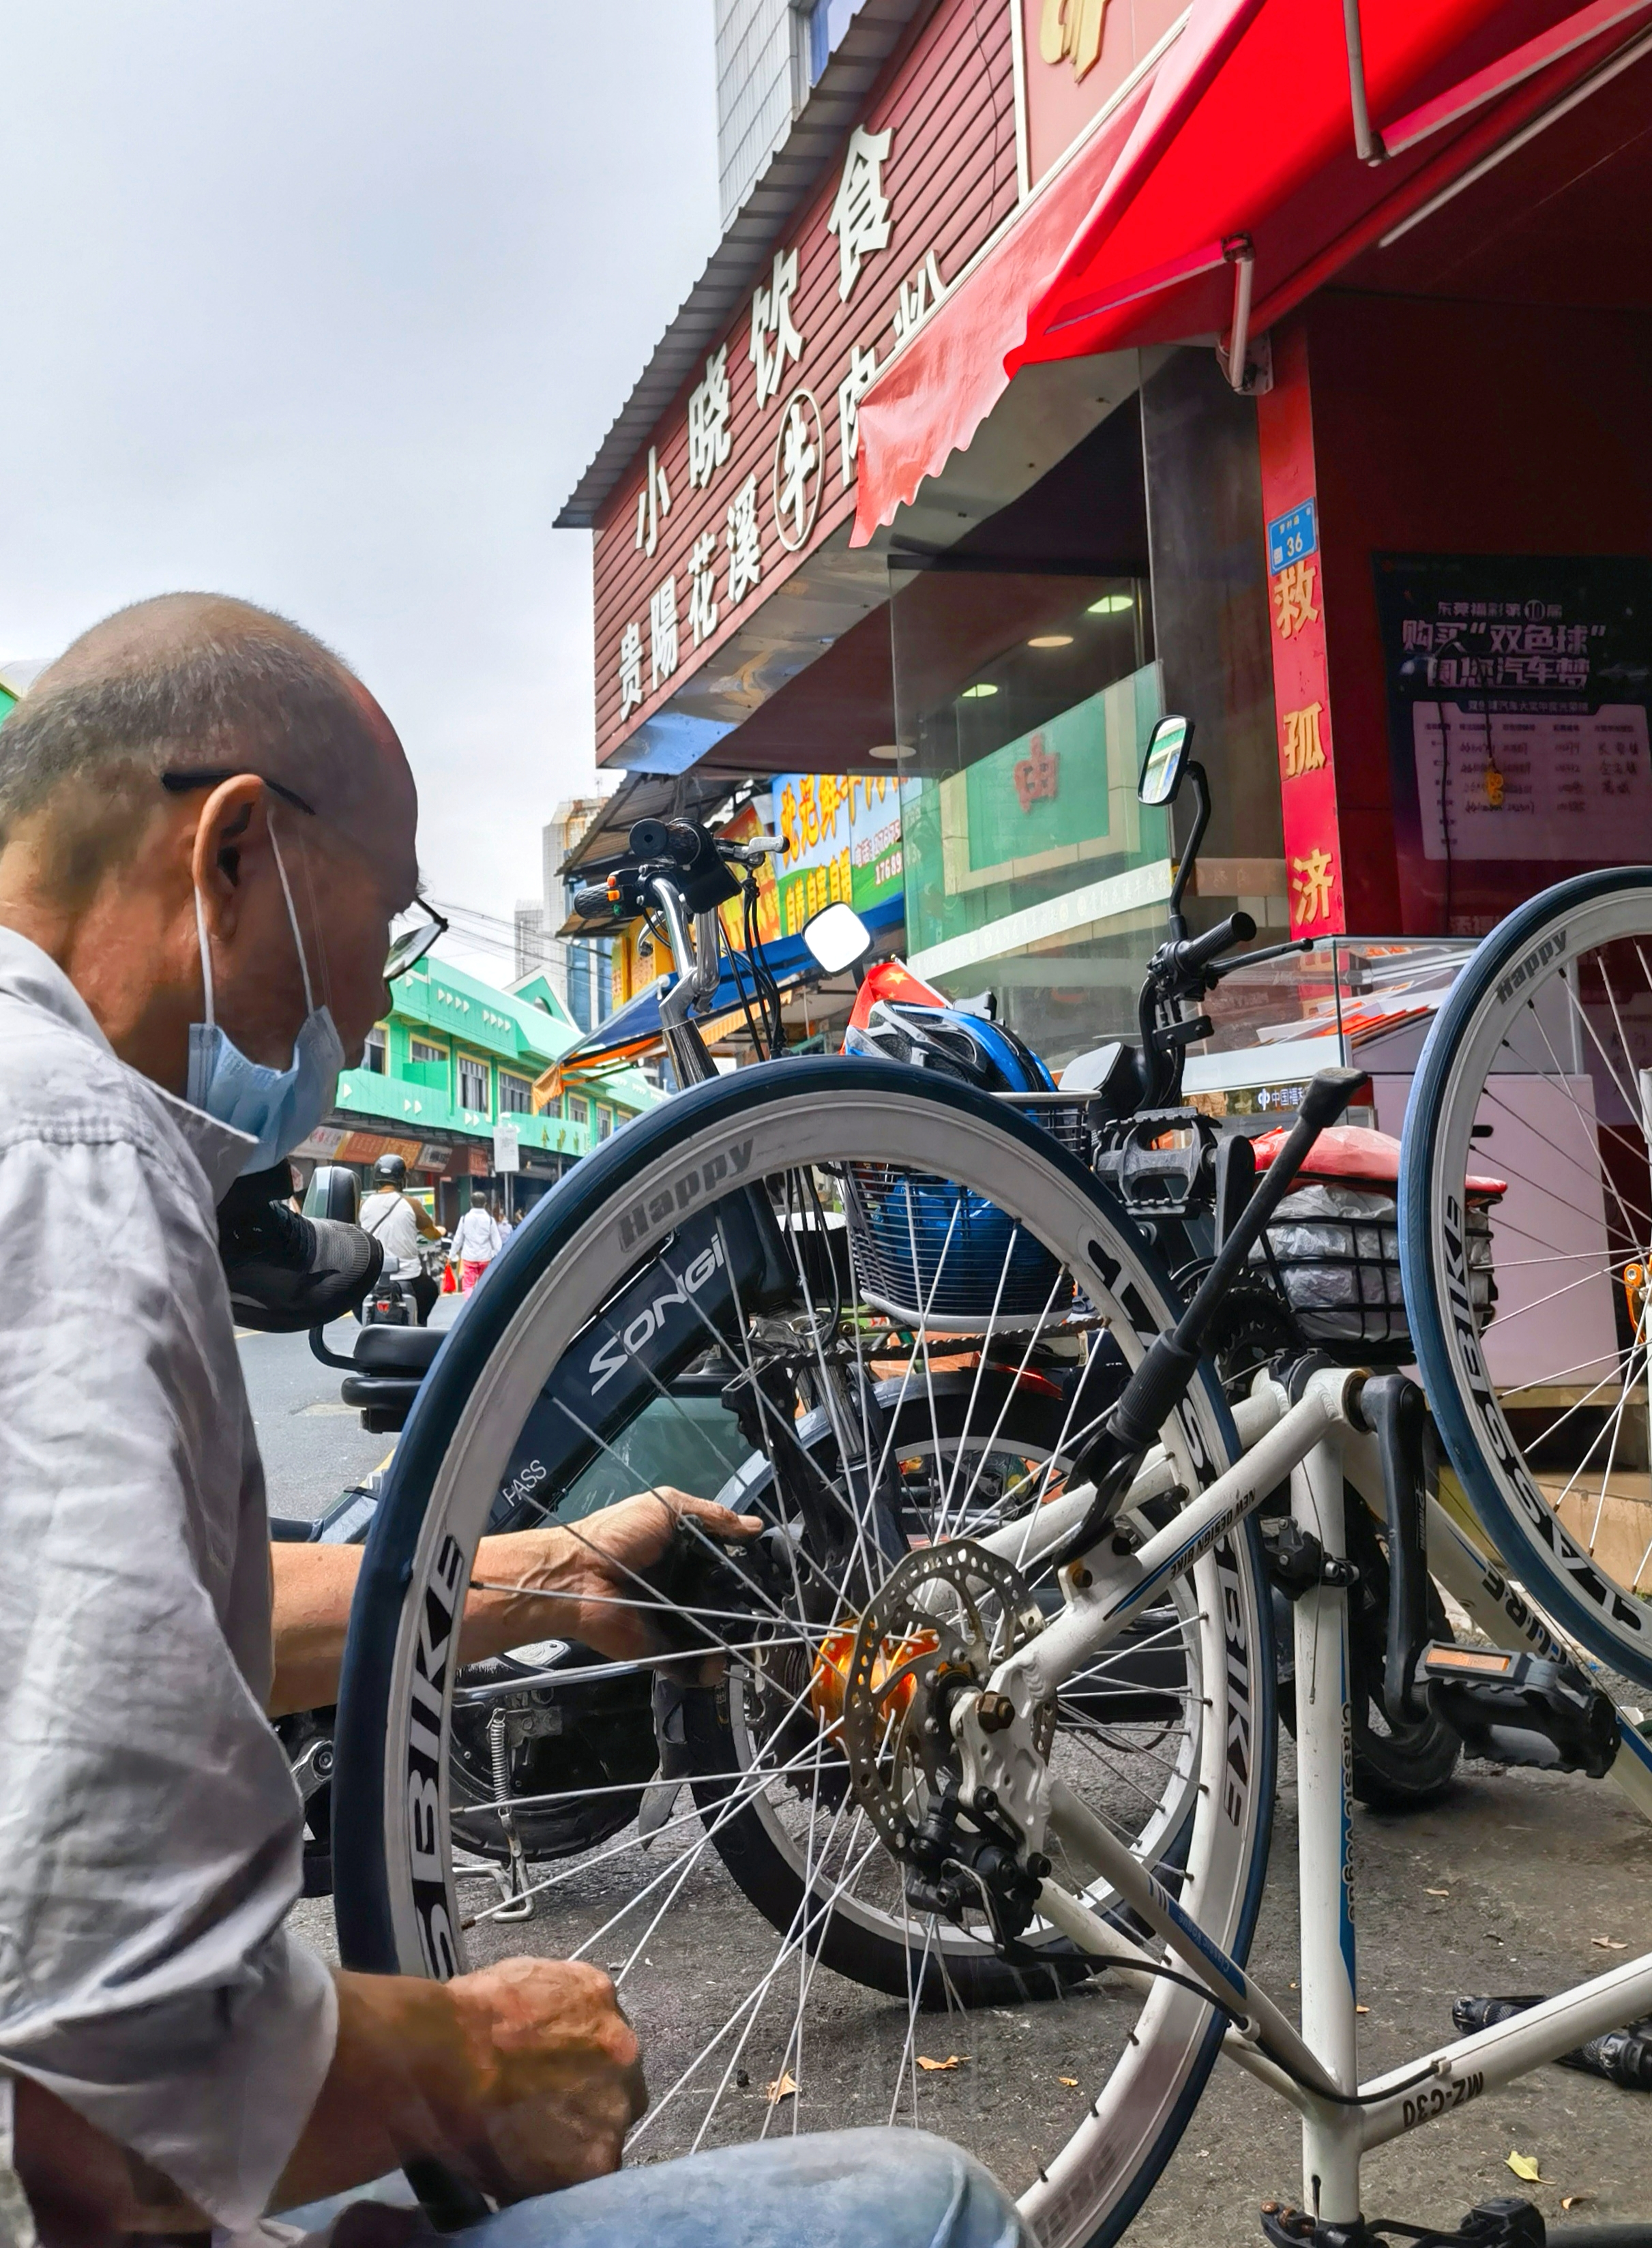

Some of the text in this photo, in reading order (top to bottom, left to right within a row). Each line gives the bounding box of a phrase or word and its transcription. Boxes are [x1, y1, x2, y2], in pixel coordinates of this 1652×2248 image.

[1286, 531, 1303, 557] 36
[1169, 1488, 1256, 1580] NEW DESIGN BIKE
[1402, 2071, 1485, 2129] MZ-C30
